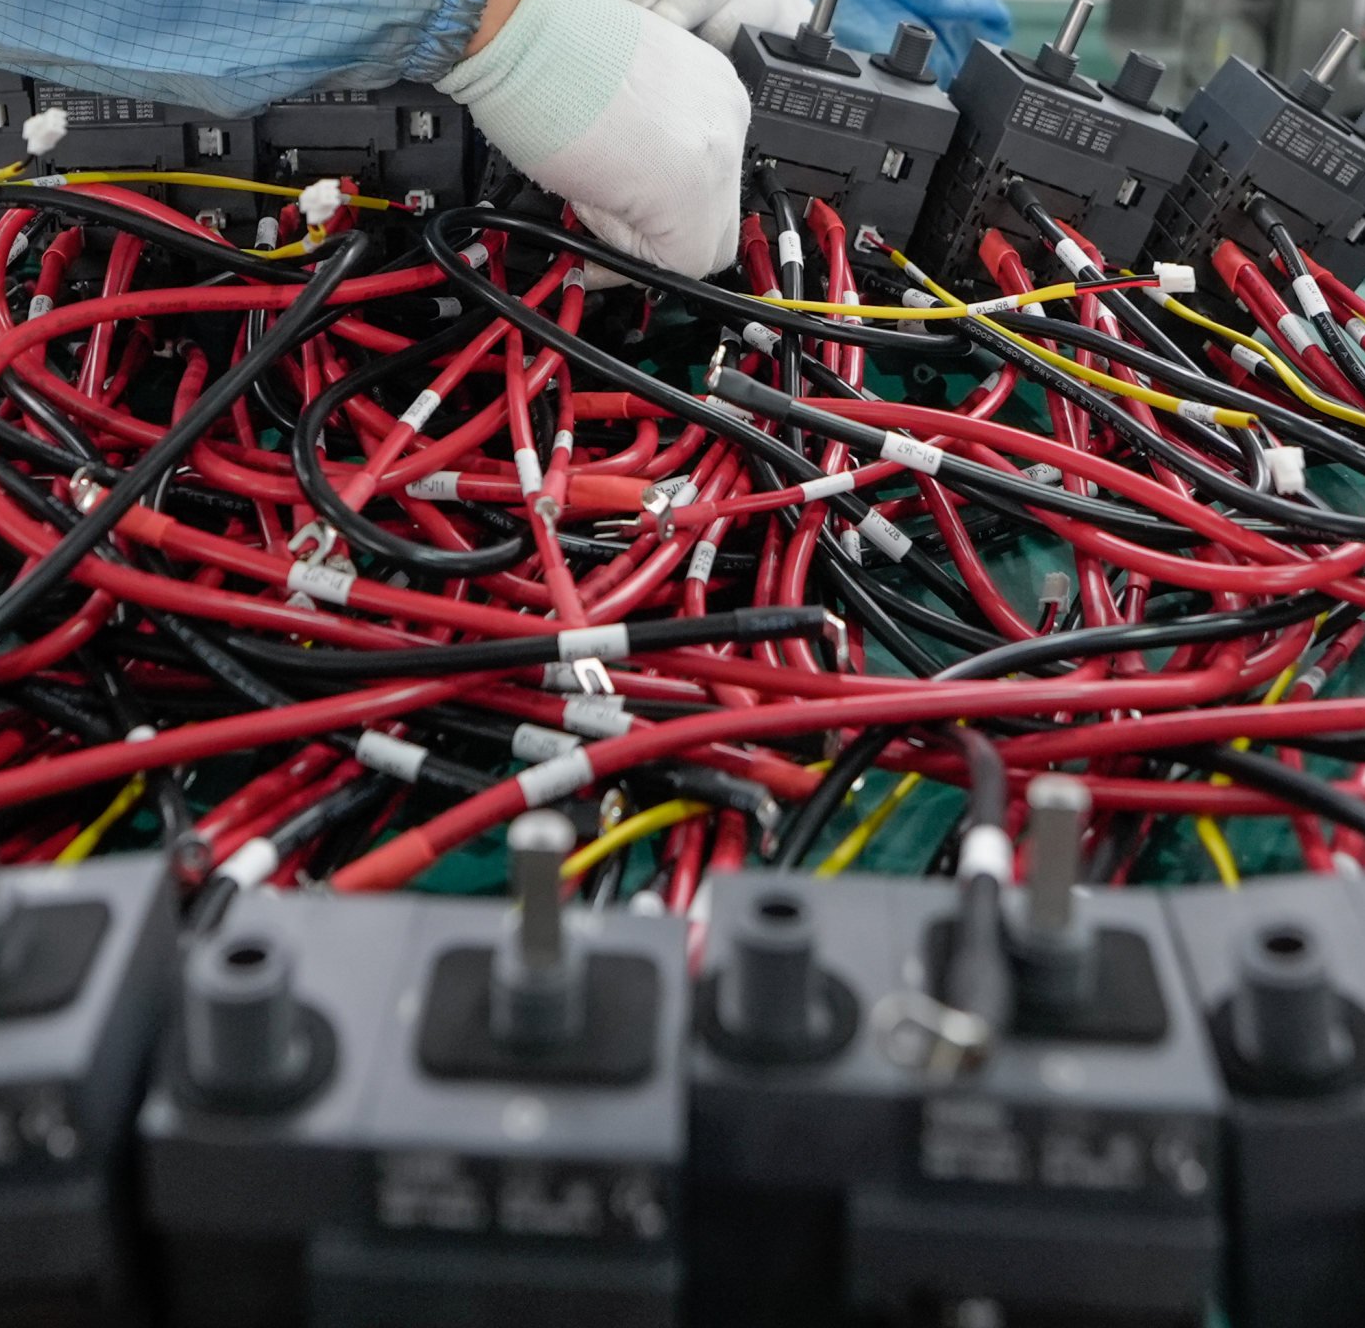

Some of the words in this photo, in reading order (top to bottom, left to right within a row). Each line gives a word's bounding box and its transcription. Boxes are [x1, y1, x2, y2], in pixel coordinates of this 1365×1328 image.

[965, 323, 994, 343] 2000V
[897, 442, 935, 464] P1-J67
[870, 511, 901, 541] P1-J28
